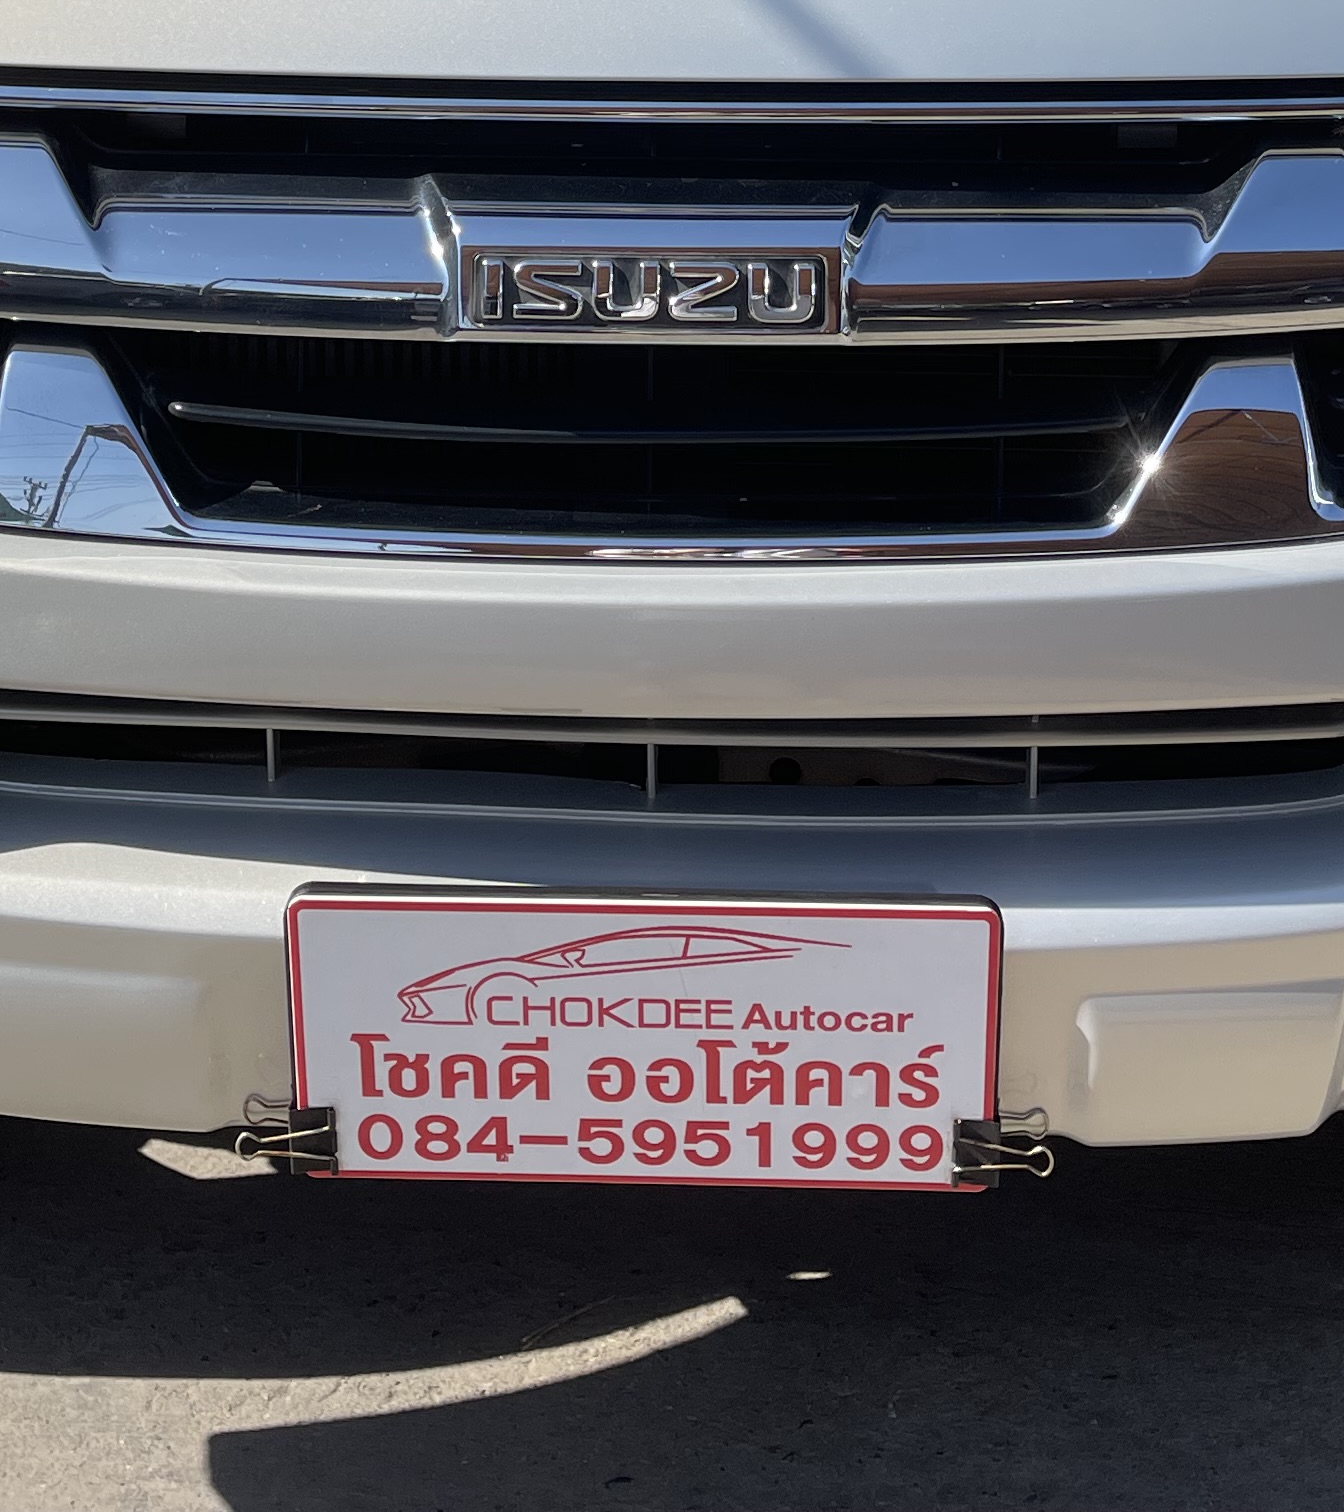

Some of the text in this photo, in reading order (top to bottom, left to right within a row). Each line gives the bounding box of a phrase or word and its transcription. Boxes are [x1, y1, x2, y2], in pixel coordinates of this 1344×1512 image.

[481, 258, 817, 324] ISUZU
[486, 995, 915, 1034] CHOKDEE Autocar
[350, 1033, 945, 1109] โชคดี ออโต้คาร์
[357, 1114, 945, 1171] 084-5951999
